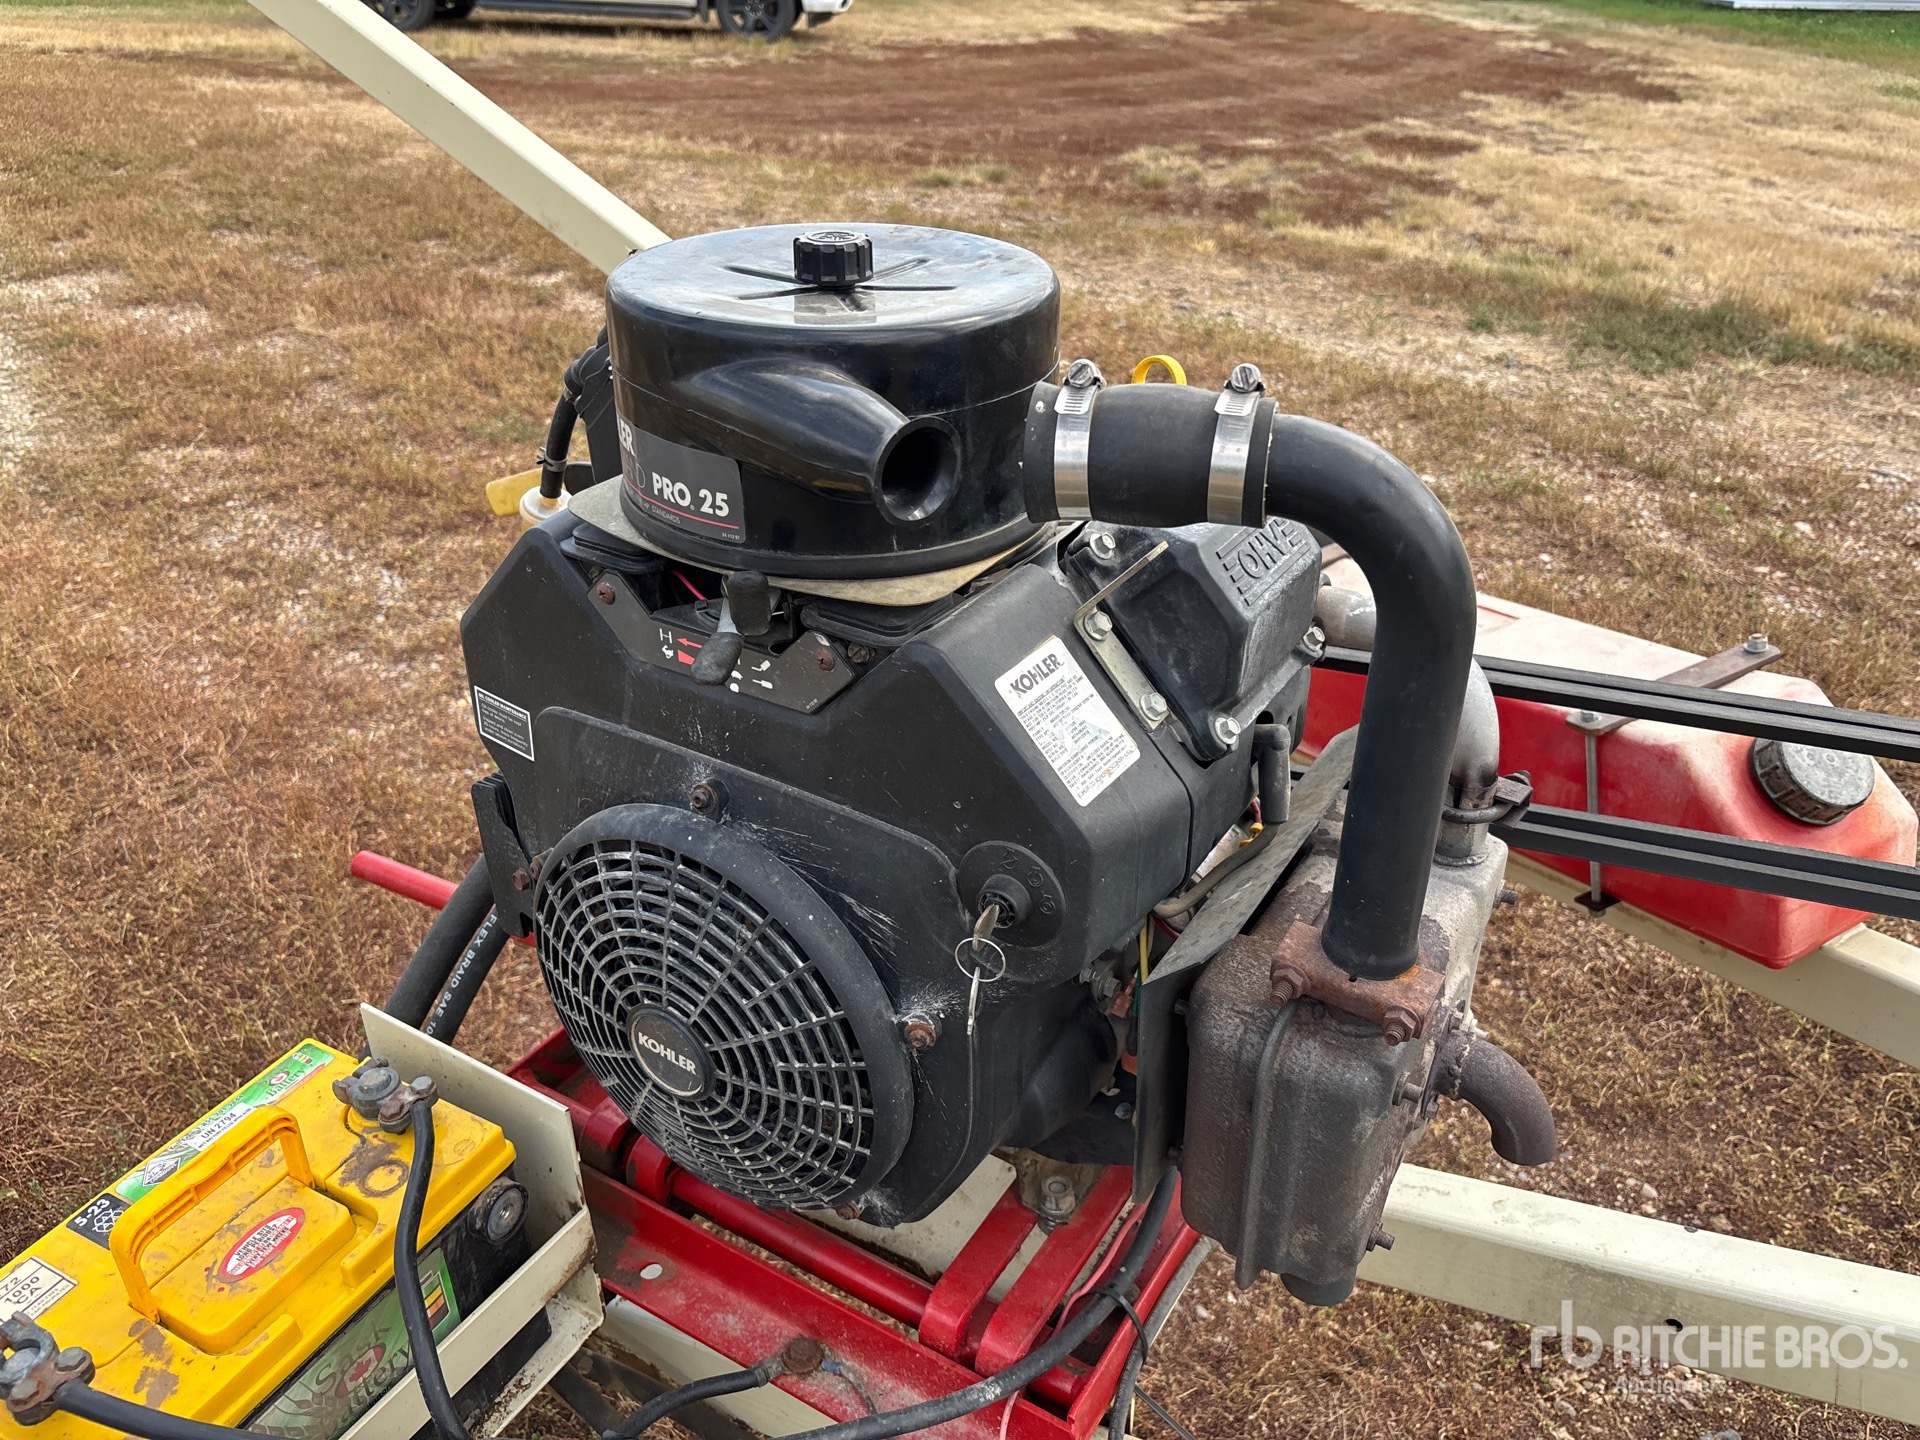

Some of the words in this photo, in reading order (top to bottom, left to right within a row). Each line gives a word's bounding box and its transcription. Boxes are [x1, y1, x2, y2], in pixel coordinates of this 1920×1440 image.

[652, 471, 692, 507] PRO
[699, 488, 729, 517] 25
[1010, 653, 1063, 697] KOHLER
[473, 913, 498, 947] FLEX
[451, 949, 476, 988] BRAID
[435, 991, 452, 1018] SAE
[638, 1031, 697, 1076] KOHLER
[266, 1067, 306, 1097] Battery
[201, 1127, 215, 1139] UN
[214, 1111, 236, 1129] 2794
[74, 1199, 111, 1227] 5-23
[234, 1236, 257, 1255] VEHICLE
[256, 1224, 269, 1235] SITS
[236, 1247, 252, 1261] LONG
[245, 1252, 260, 1266] EVERY
[260, 1242, 271, 1252] FEW
[271, 1226, 288, 1242] WEEKS
[3, 1276, 21, 1292] 72
[4, 1276, 40, 1303] 1000
[15, 1286, 42, 1304] CA
